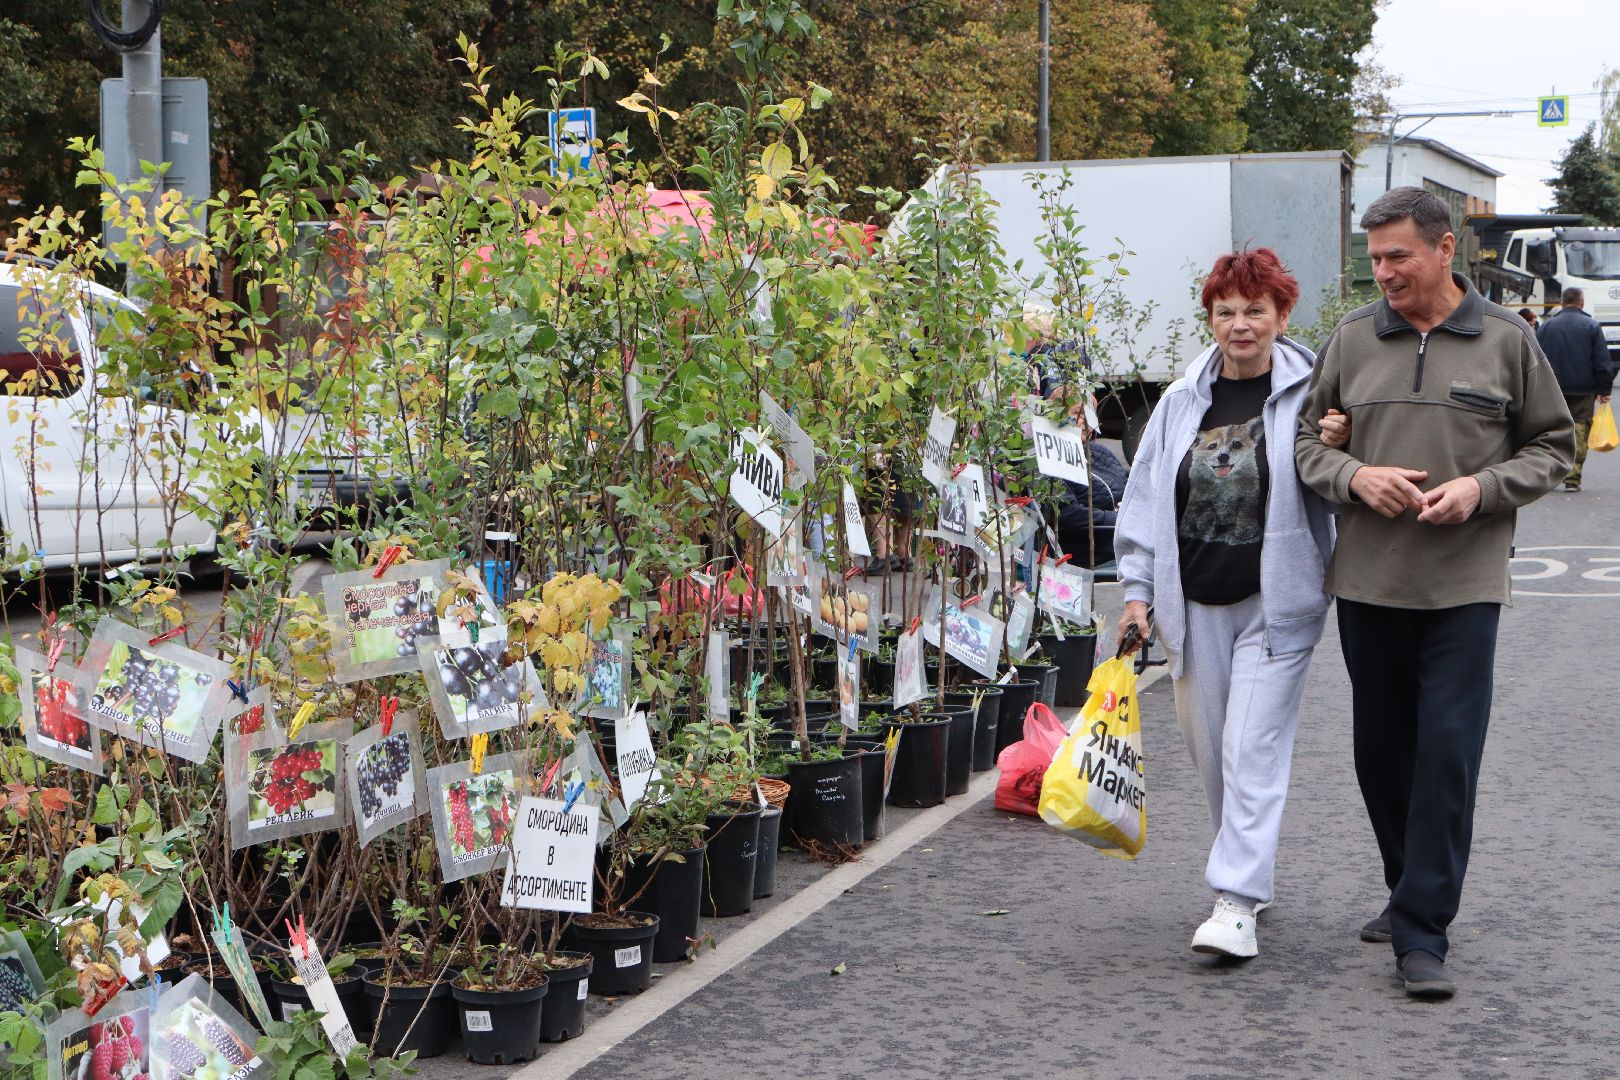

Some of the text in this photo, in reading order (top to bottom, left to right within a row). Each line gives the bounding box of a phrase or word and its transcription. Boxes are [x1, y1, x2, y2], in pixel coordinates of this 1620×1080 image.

[1035, 431, 1084, 469] ГРУША
[343, 583, 415, 602] Смородина
[344, 599, 387, 614] черная
[347, 612, 430, 633] Селеченская
[348, 633, 356, 648] 2
[92, 702, 129, 723] ЧУДНОЕ
[478, 704, 513, 718] БАГИРА
[1078, 751, 1146, 813] Маркет
[265, 816, 284, 826] РЕД
[527, 807, 588, 837] СМОРОДИНА
[547, 845, 554, 866] В
[506, 874, 587, 902] АССОРТИМЕНТЕ
